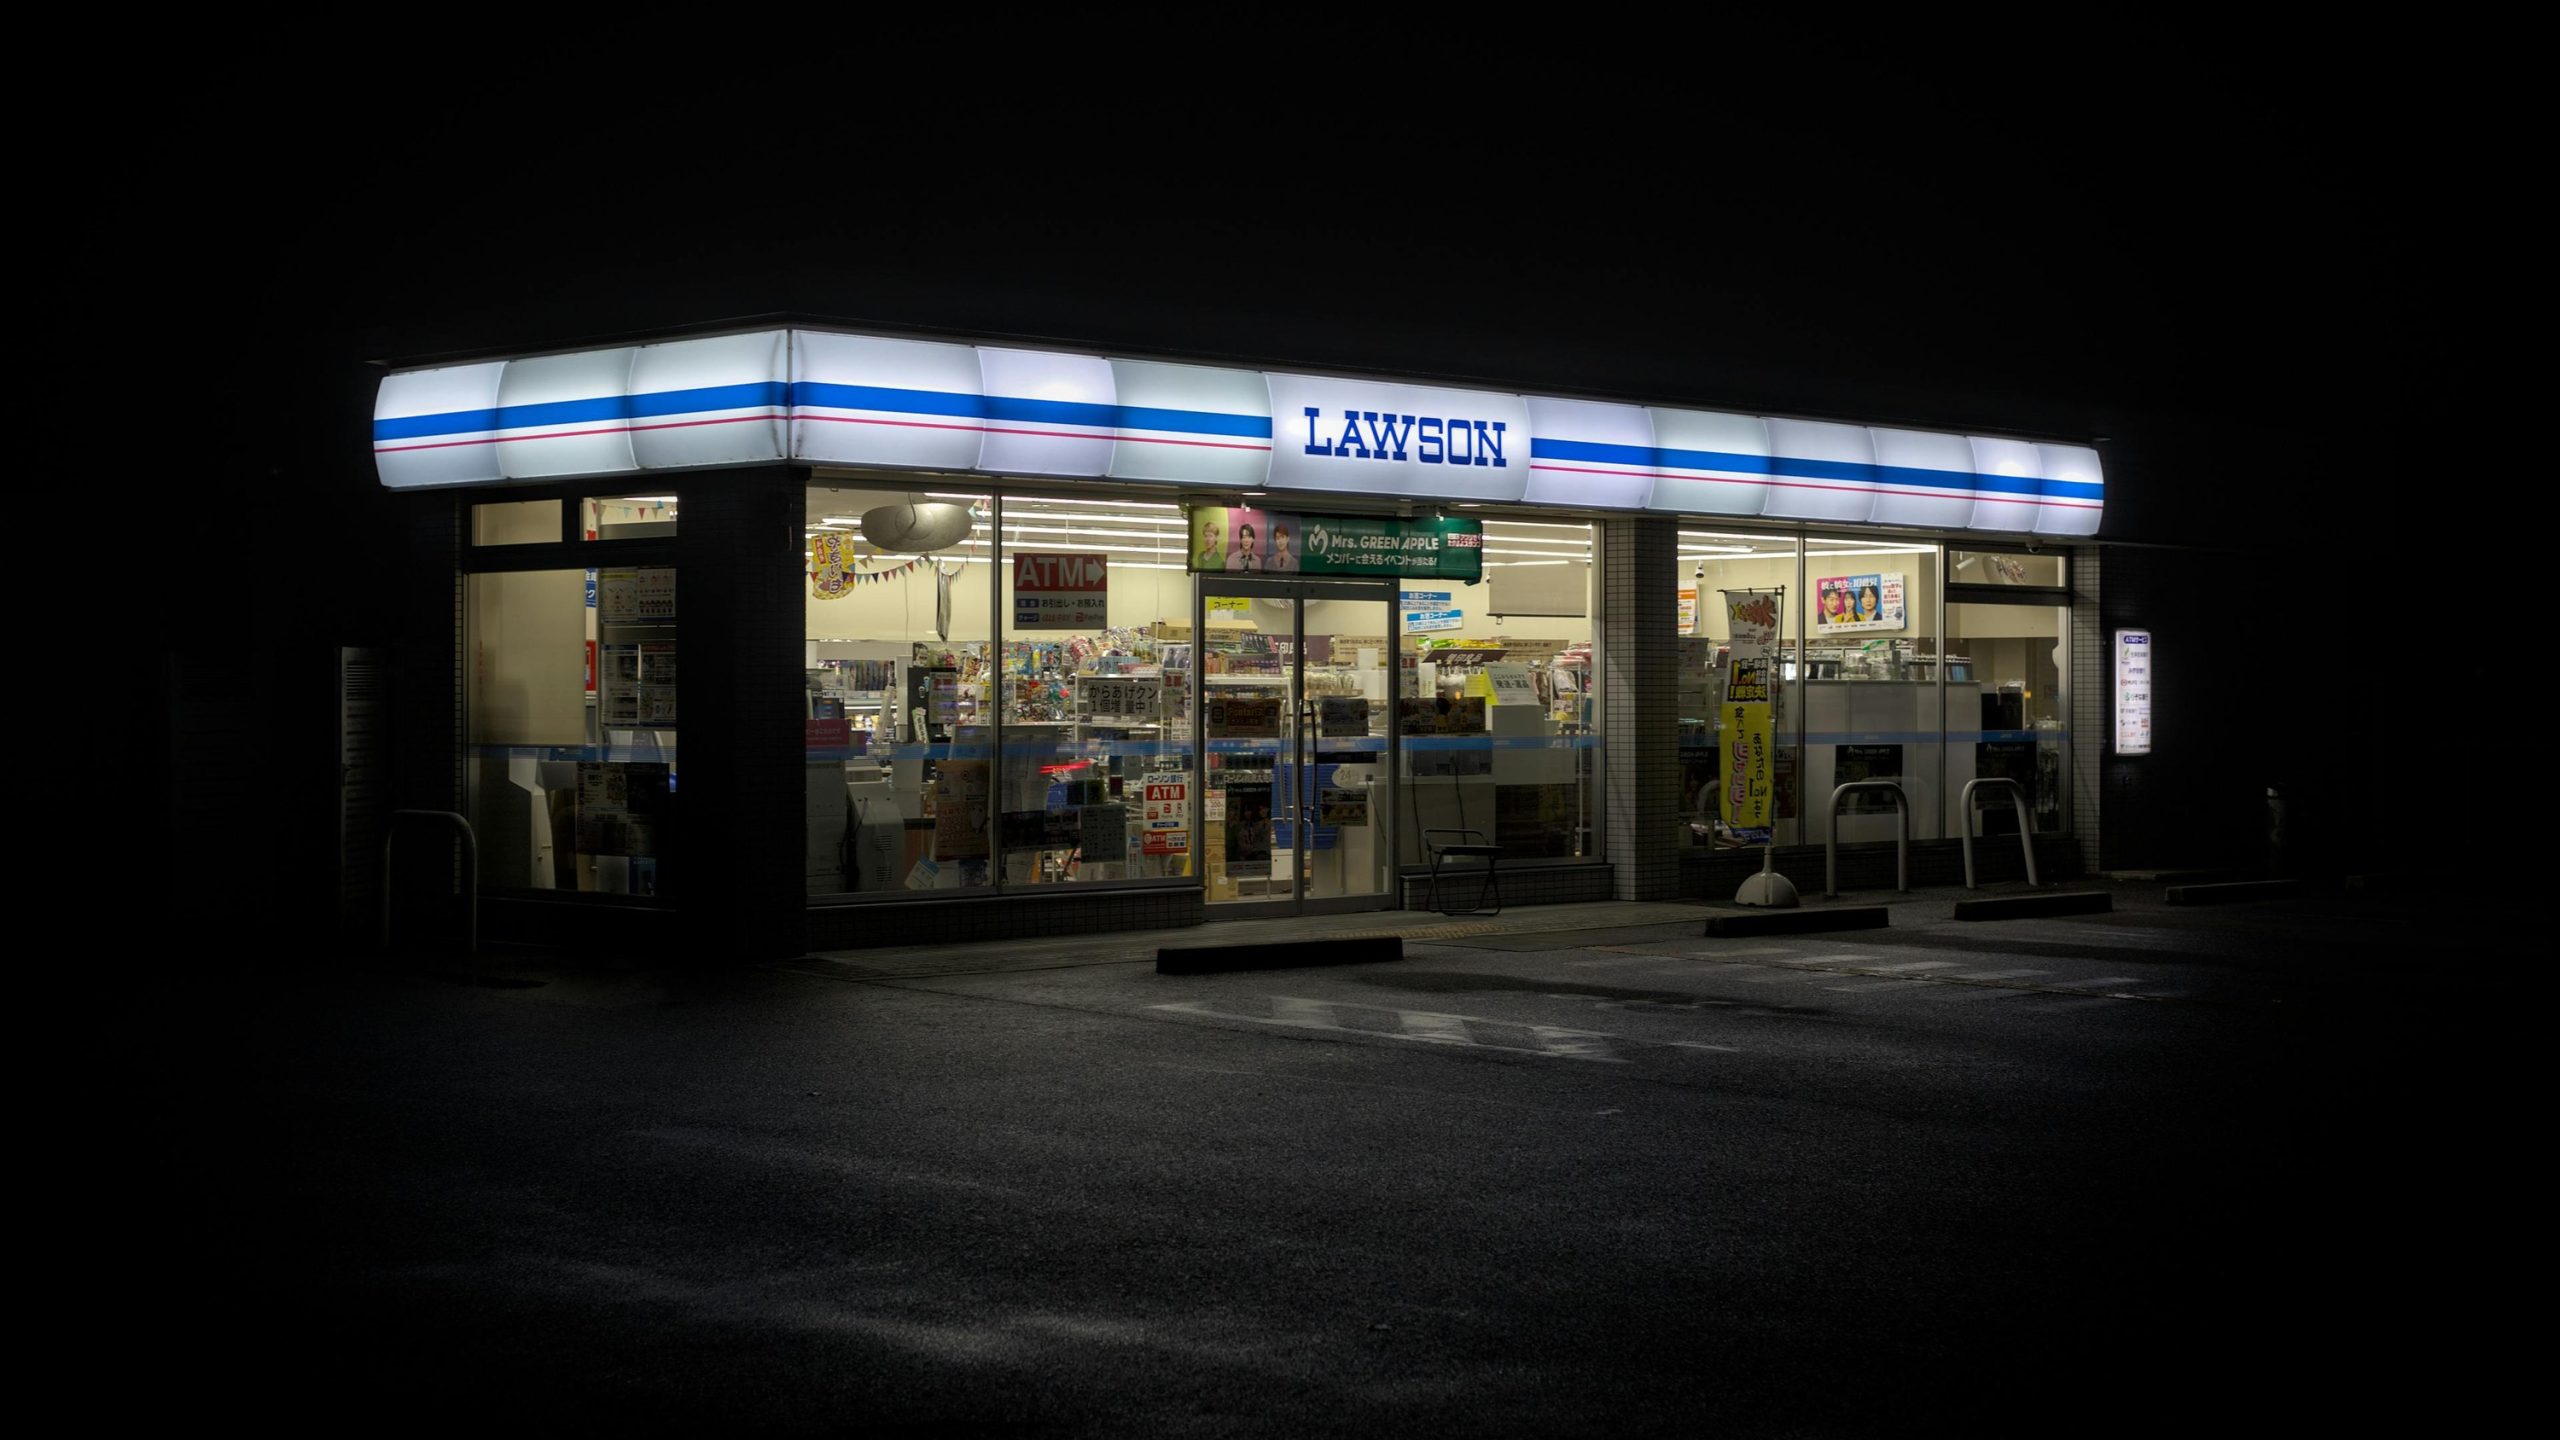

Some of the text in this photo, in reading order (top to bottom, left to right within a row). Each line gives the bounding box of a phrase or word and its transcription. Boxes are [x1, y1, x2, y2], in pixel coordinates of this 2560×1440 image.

[1304, 407, 1506, 467] LAWSON
[1331, 534, 1357, 549] Mrs.
[1360, 535, 1400, 550] GREEN
[1401, 537, 1439, 550] APPLE
[1017, 557, 1084, 587] ATM
[1089, 685, 1157, 699] からあげクン
[1151, 786, 1180, 799] ATM
